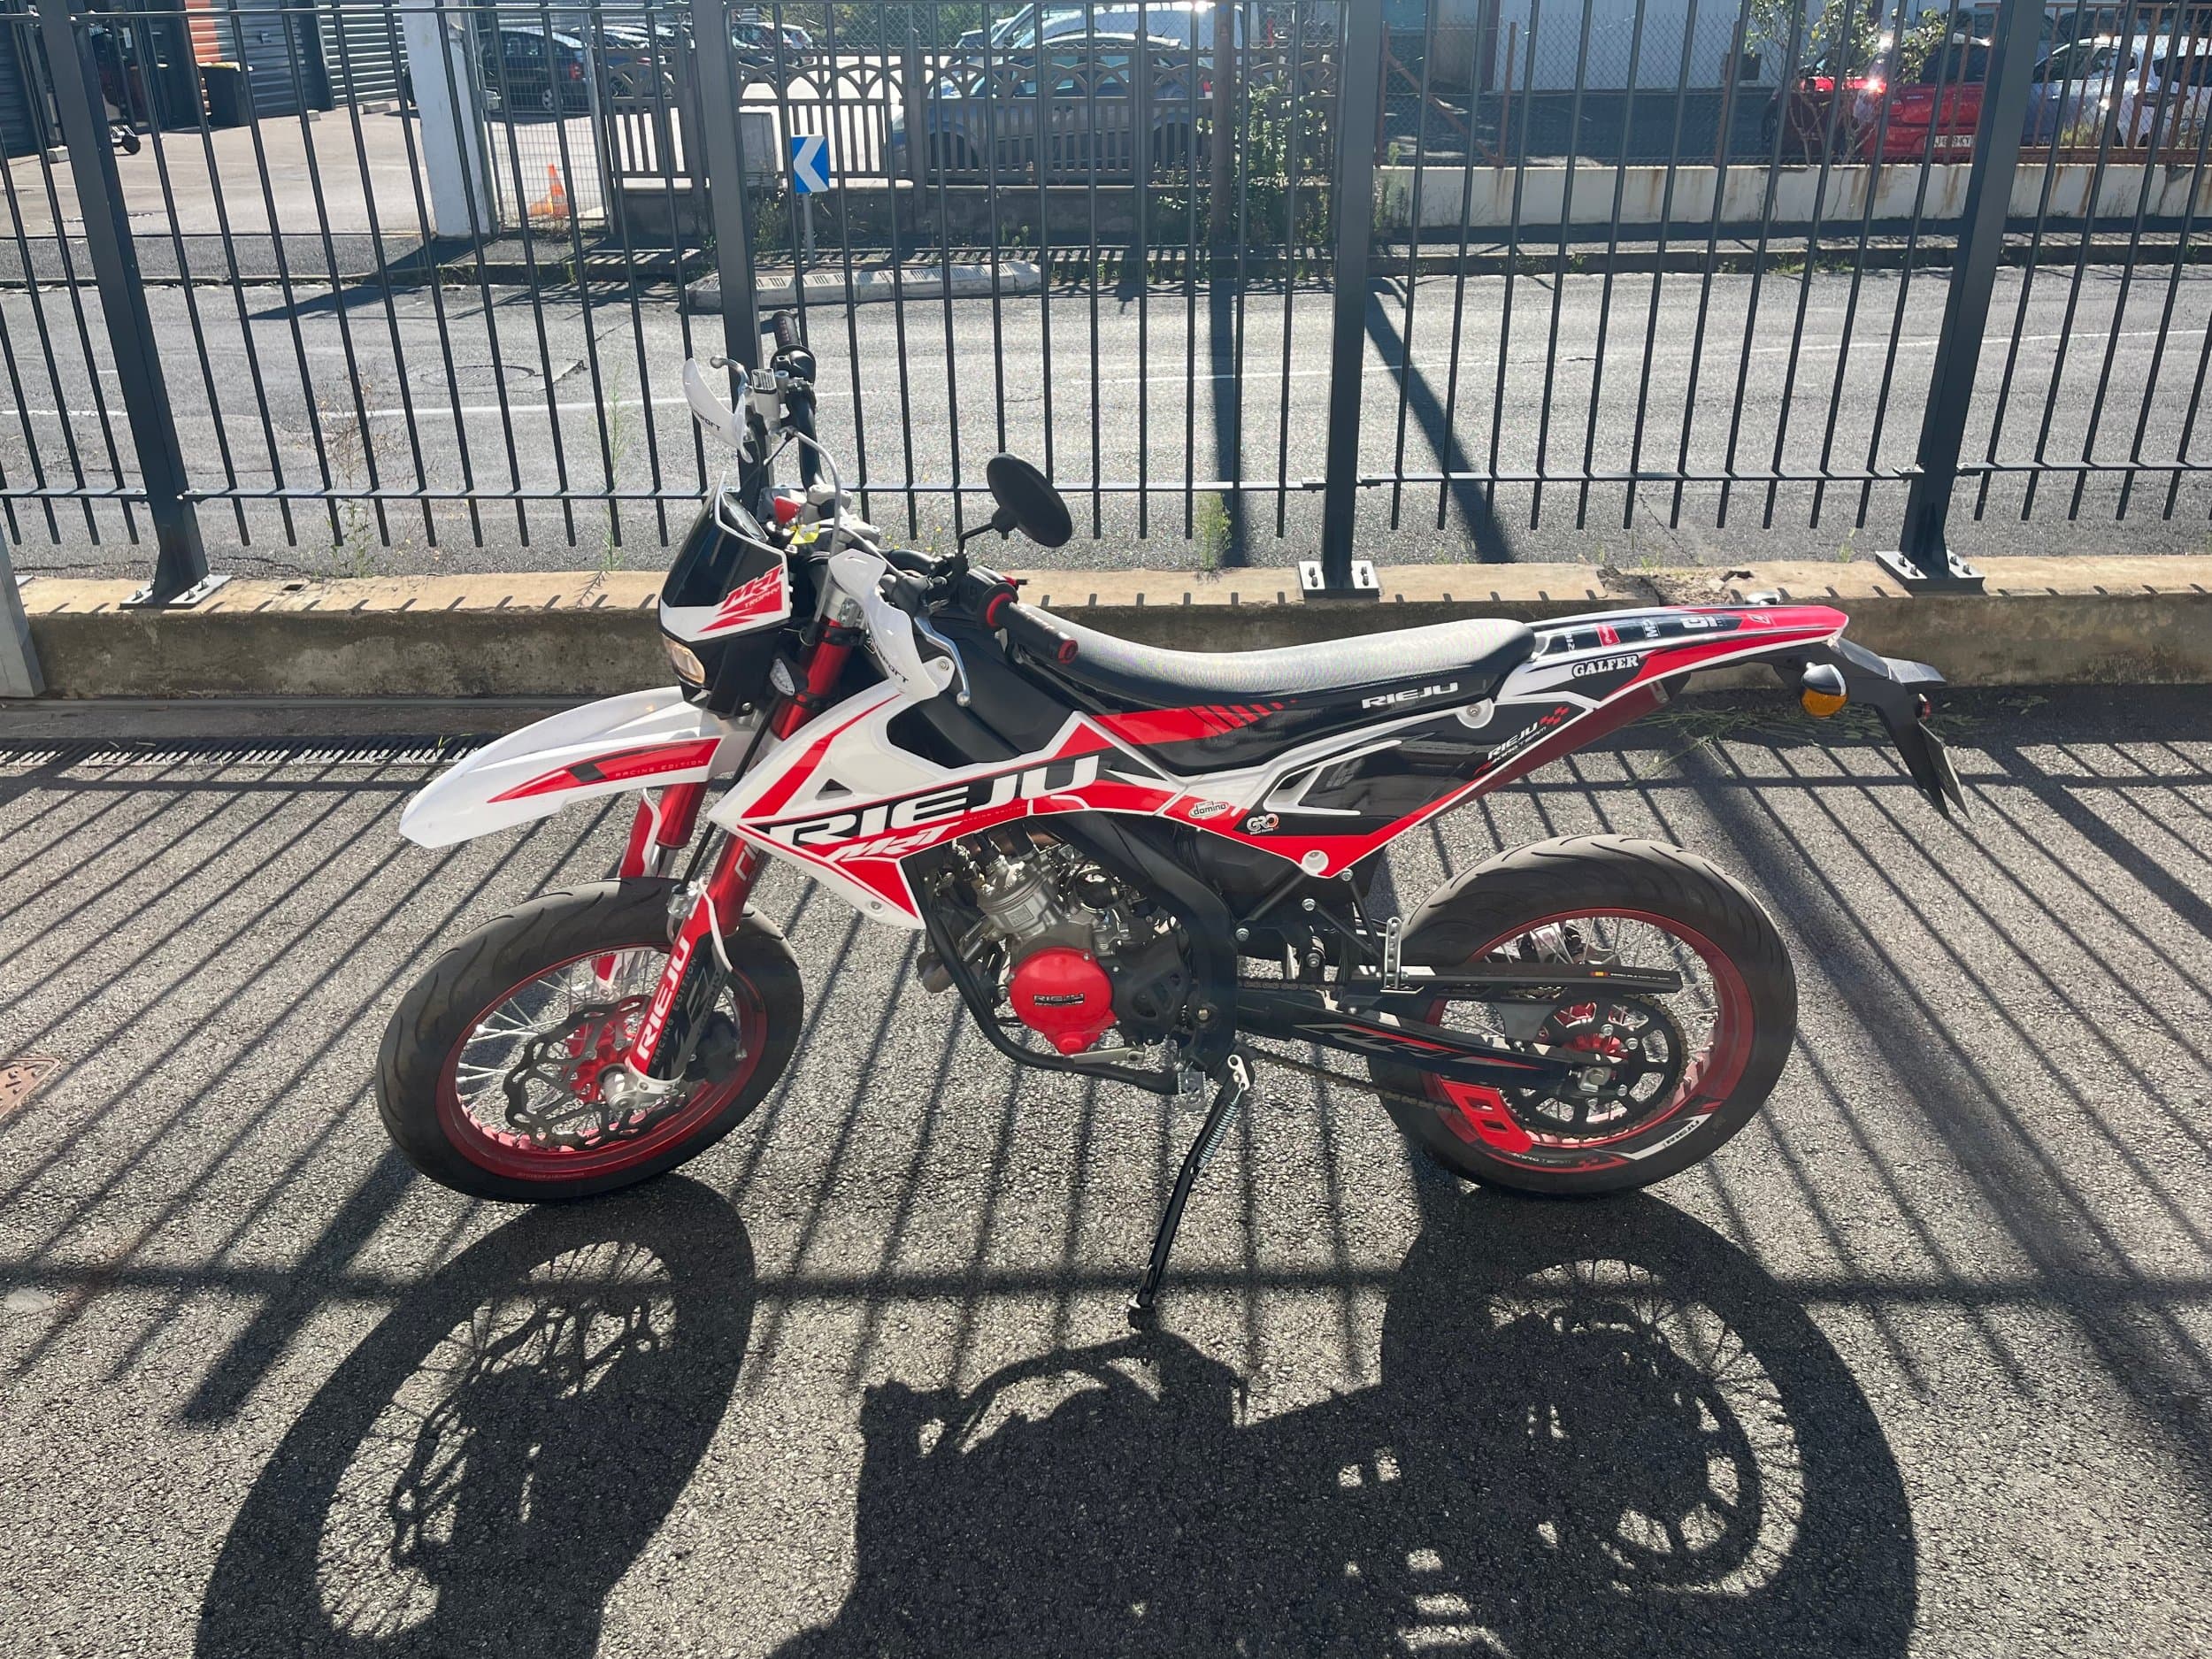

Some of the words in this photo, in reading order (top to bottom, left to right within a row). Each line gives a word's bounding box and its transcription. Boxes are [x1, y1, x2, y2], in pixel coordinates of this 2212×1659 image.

[745, 586, 780, 608] TROPHY
[1572, 655, 1639, 678] GALFER
[1362, 682, 1459, 709] RIEJU
[1487, 721, 1539, 761] RIEJU
[614, 766, 655, 778] RACING
[660, 759, 704, 772] EDITION
[767, 755, 1100, 847] RIEJU
[1193, 802, 1227, 816] domino
[1246, 813, 1279, 832] GRO
[673, 956, 698, 1012] EDITION
[636, 935, 691, 1061] RIEJU
[1664, 1118, 1701, 1145] RIEJU
